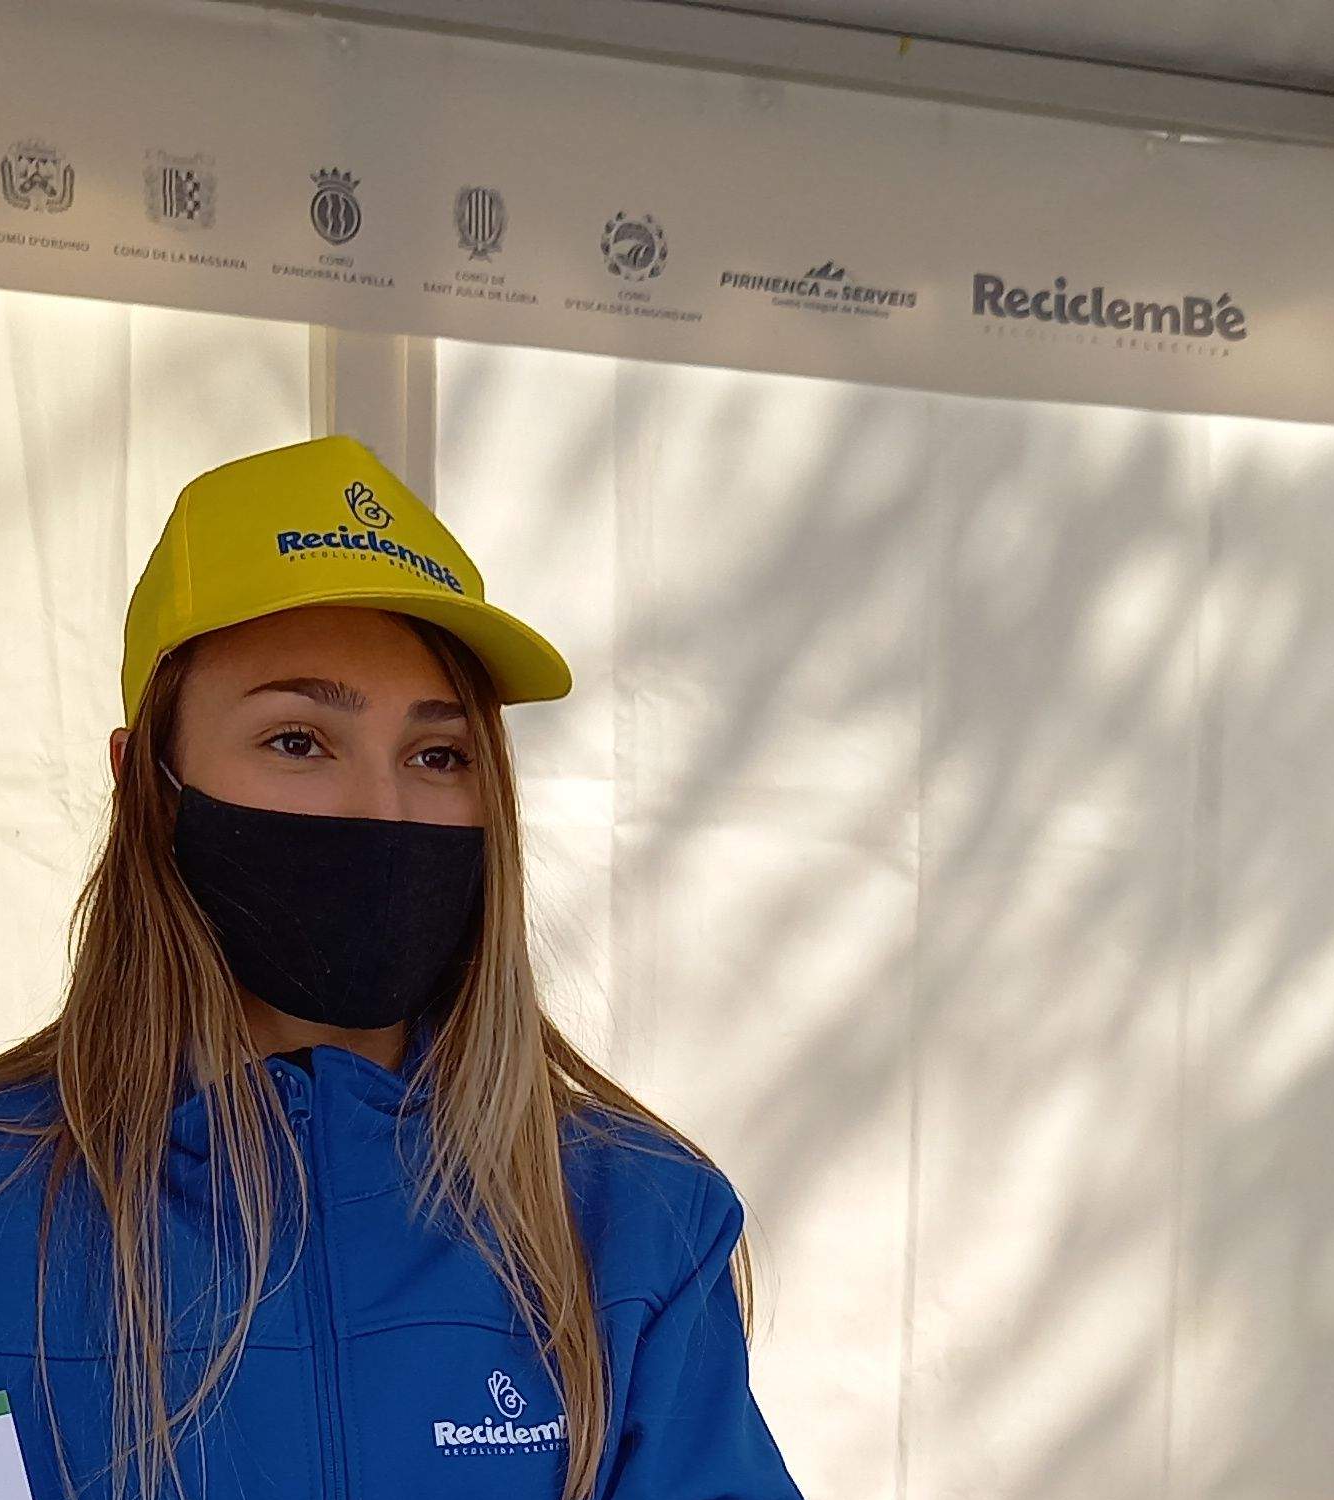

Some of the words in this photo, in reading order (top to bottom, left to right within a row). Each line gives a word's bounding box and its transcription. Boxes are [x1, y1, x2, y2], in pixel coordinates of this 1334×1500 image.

[720, 271, 820, 297] PIRINENCA
[842, 286, 917, 308] SERVEIS
[973, 273, 1247, 341] ReciclemBé
[277, 526, 464, 594] ReciclemBé
[290, 551, 377, 562] RECOLLIDA
[434, 1415, 568, 1446] Reciclem
[444, 1448, 515, 1456] RECOLLIDA
